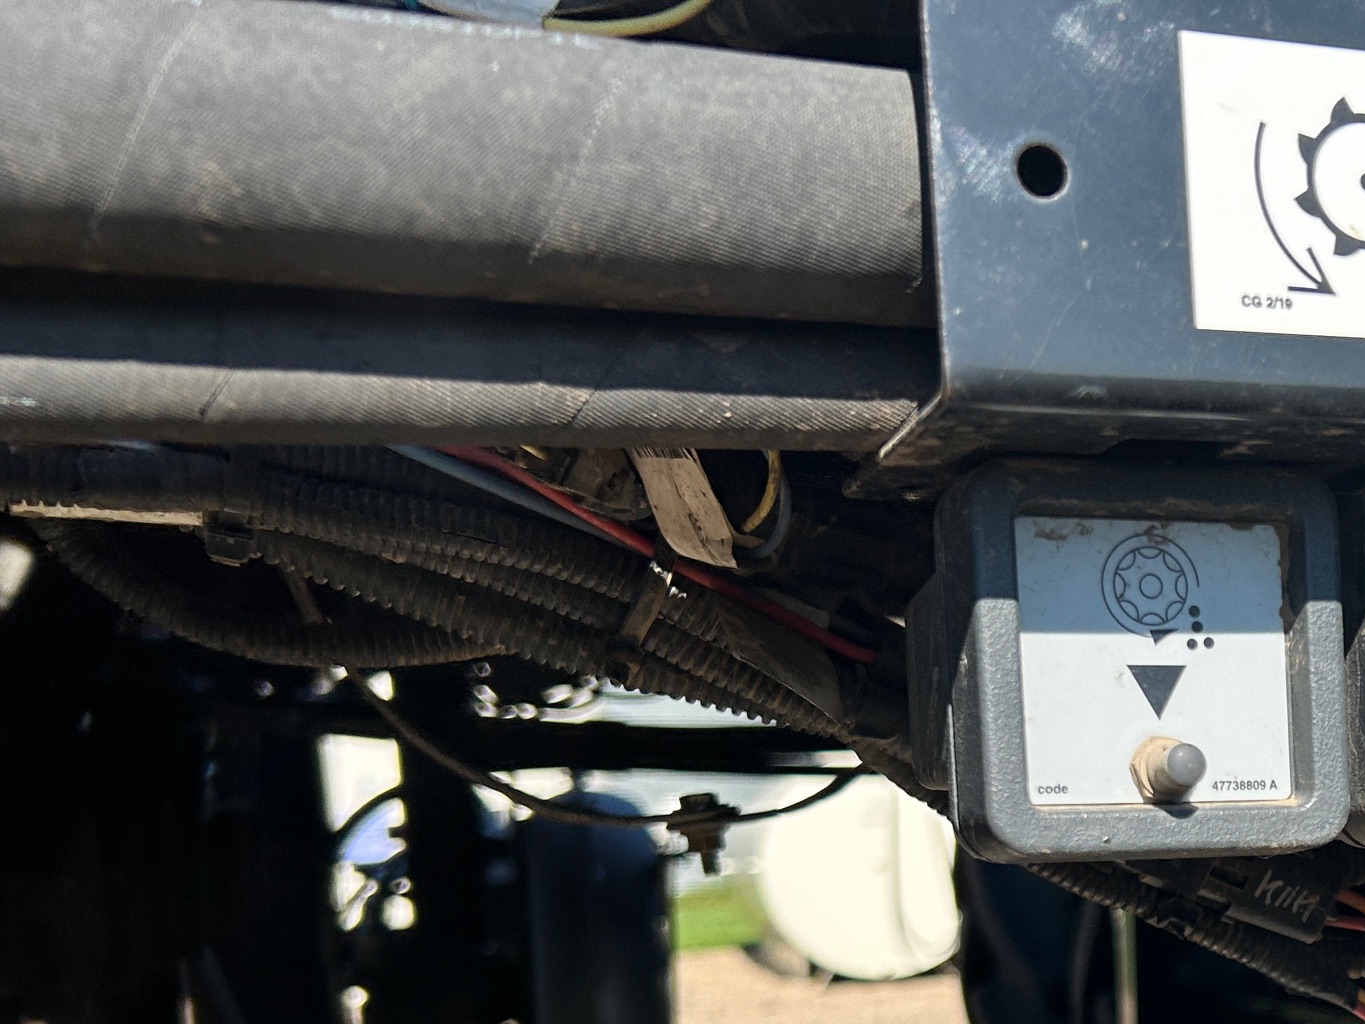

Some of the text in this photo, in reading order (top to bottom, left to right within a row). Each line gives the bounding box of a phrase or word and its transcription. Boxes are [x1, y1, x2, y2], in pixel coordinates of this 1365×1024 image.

[1241, 294, 1263, 308] CG
[1038, 783, 1069, 795] code
[1212, 779, 1278, 792] 47738809 A
